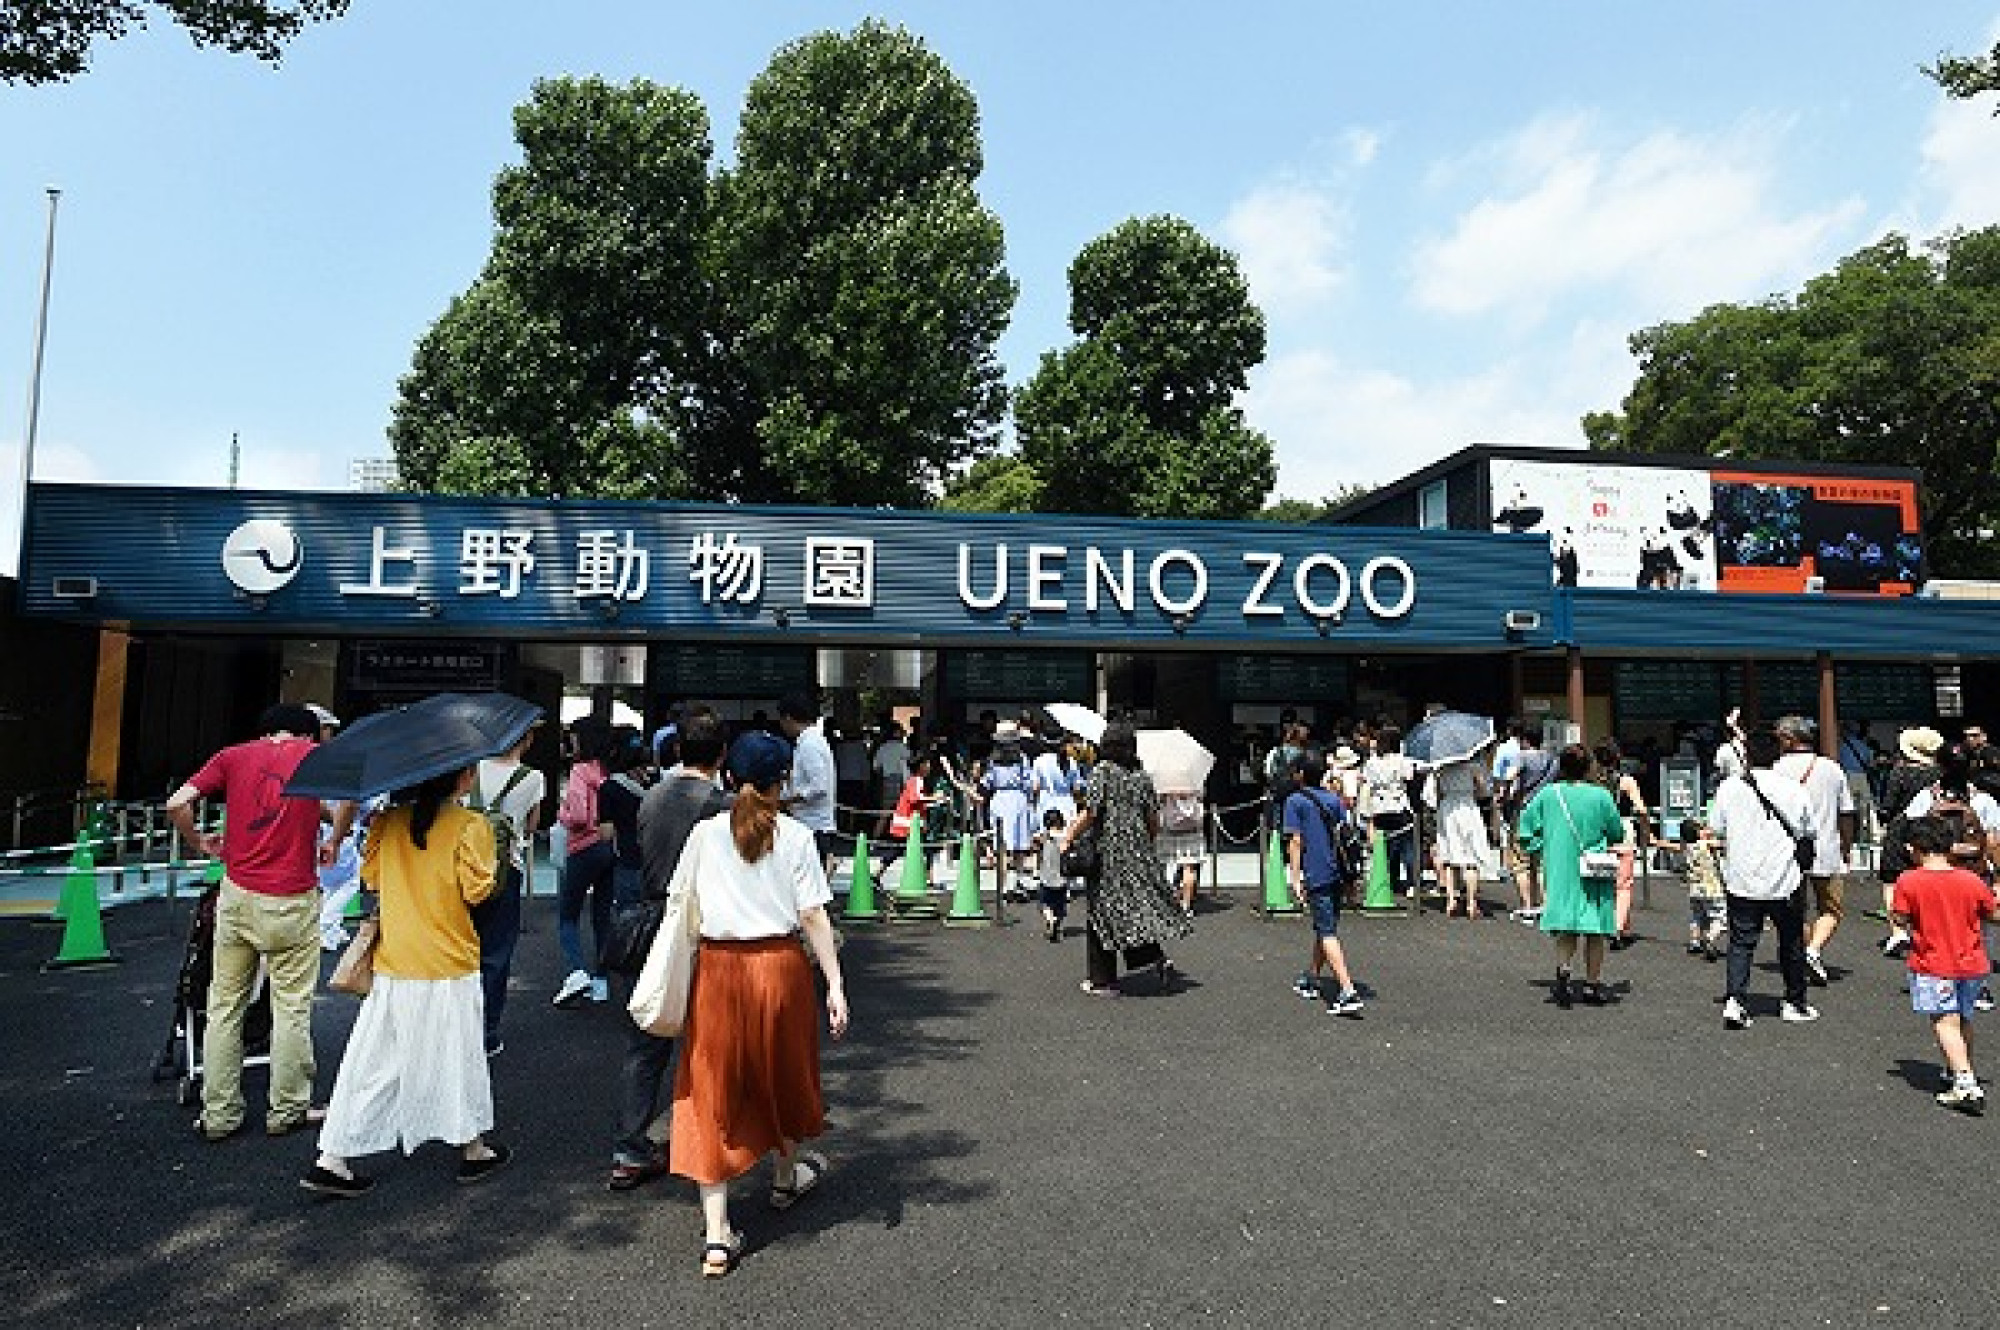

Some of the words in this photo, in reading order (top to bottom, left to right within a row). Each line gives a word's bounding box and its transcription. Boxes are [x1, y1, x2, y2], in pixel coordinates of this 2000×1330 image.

[339, 525, 876, 607] 上野動物園
[957, 542, 1208, 615] UENO
[1242, 552, 1416, 619] ZOO
